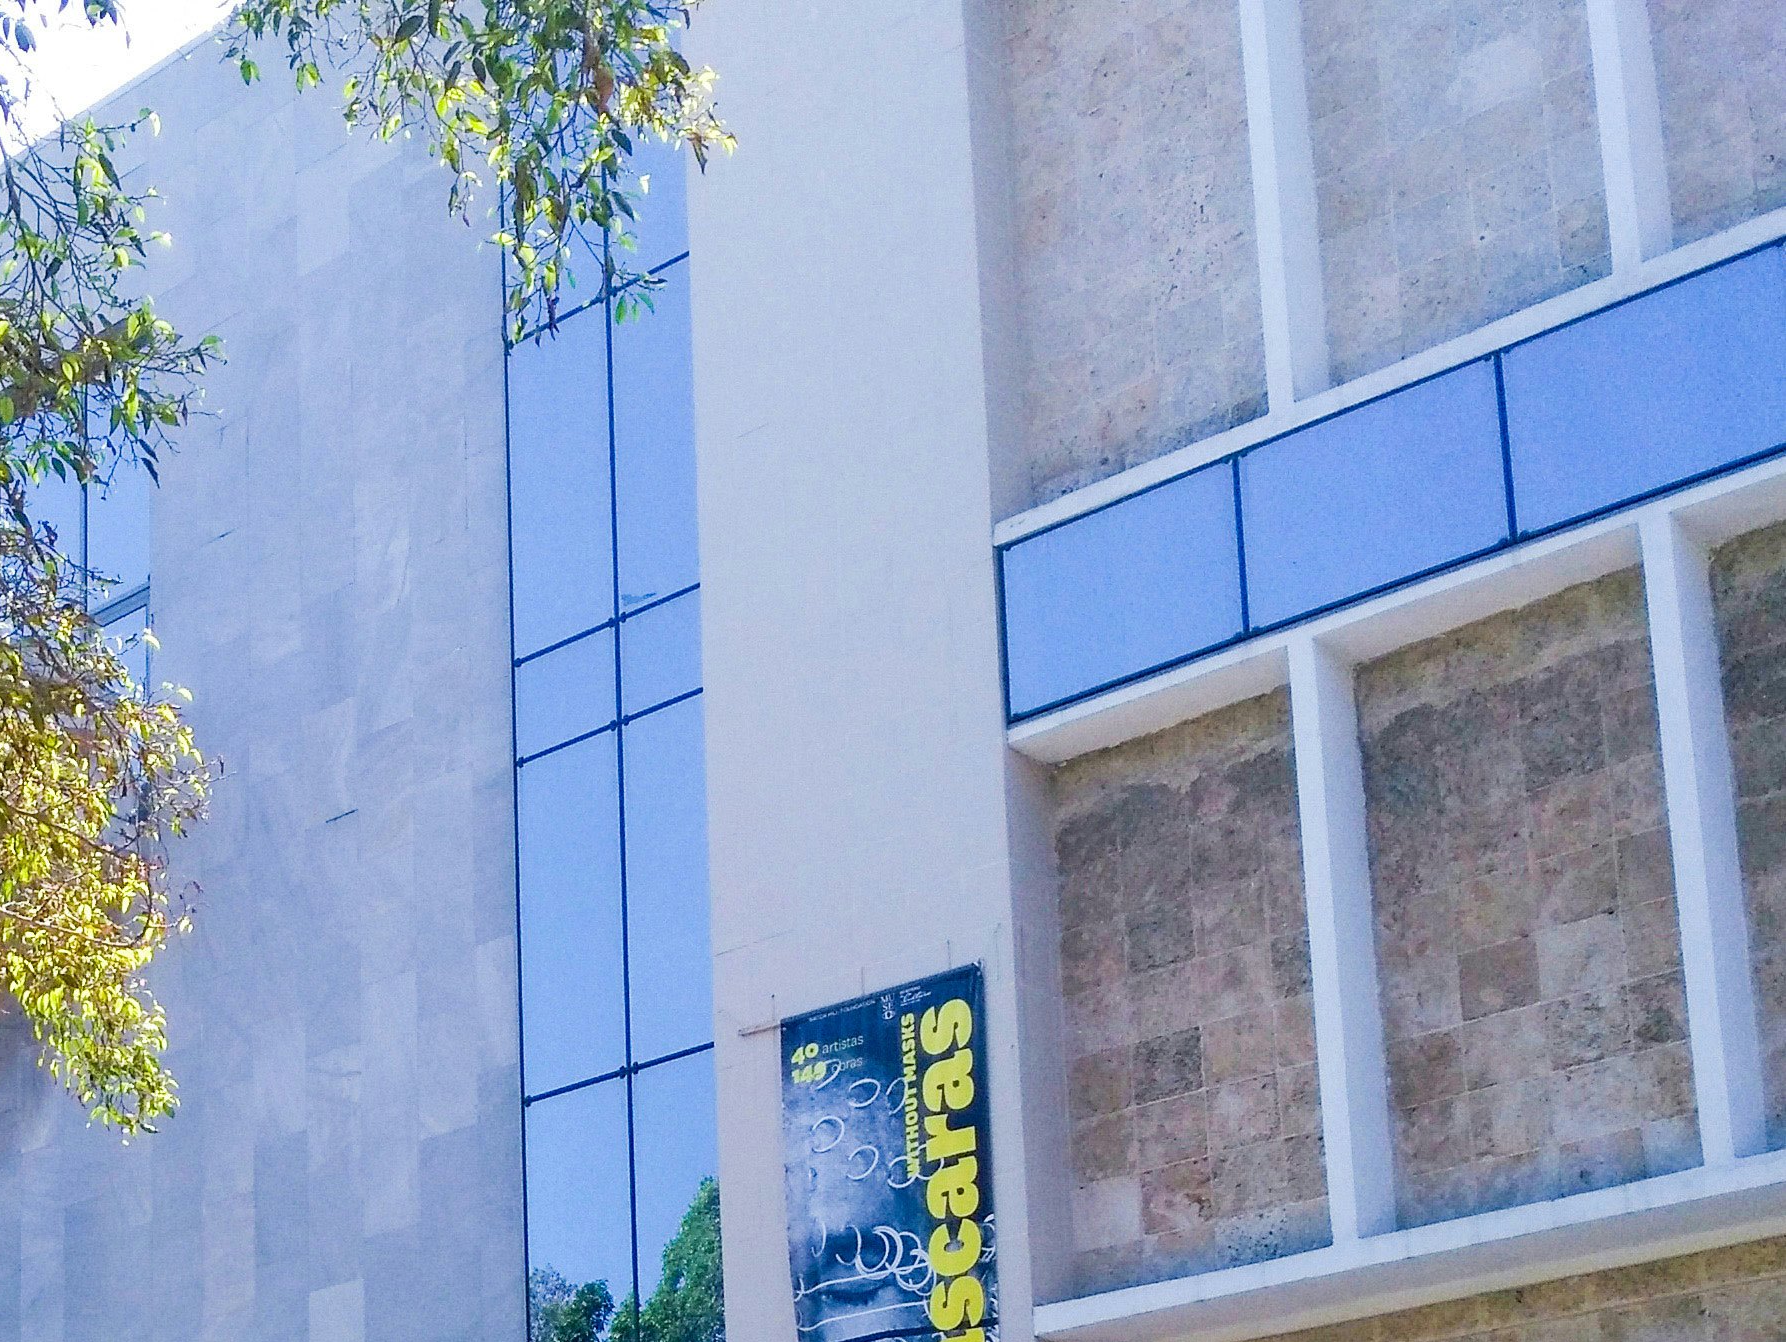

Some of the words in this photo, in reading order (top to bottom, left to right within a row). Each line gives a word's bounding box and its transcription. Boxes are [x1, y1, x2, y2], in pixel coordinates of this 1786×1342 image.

[791, 1042, 820, 1065] 40
[821, 1034, 865, 1054] artistas
[791, 1060, 827, 1085] 149
[831, 1056, 864, 1073] obras
[900, 1012, 917, 1082] MASKS
[904, 1087, 921, 1178] WITHOUT
